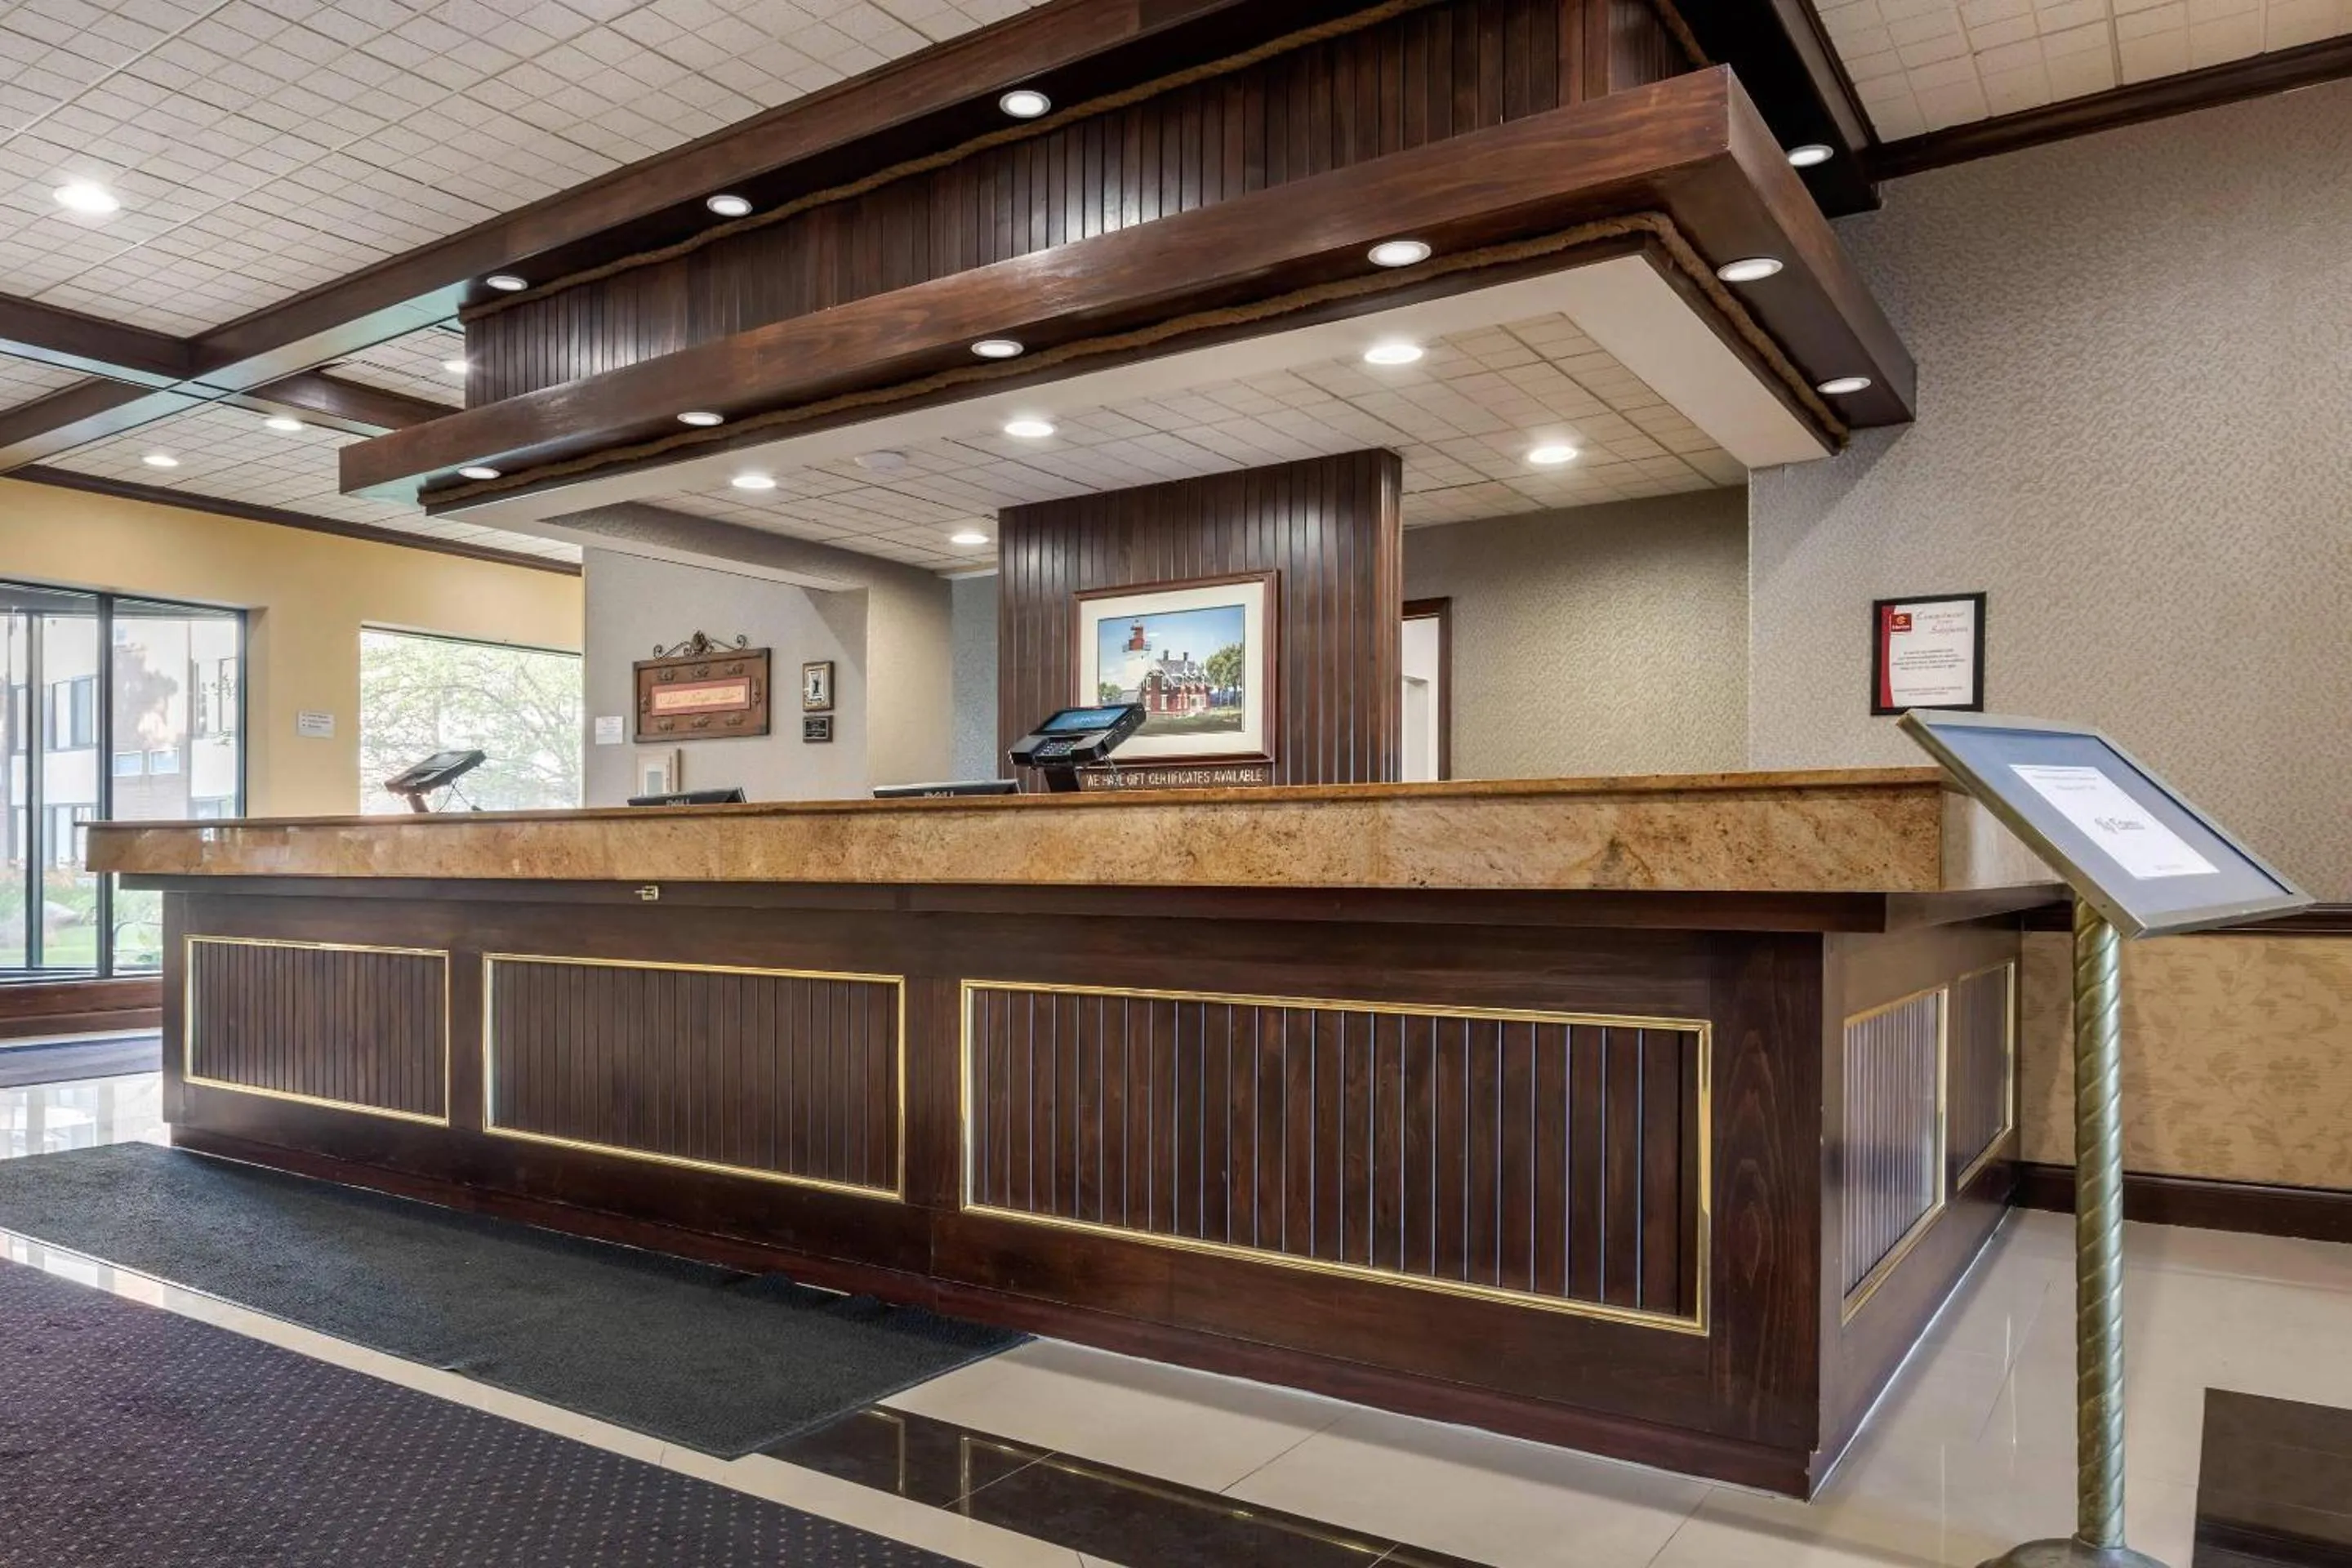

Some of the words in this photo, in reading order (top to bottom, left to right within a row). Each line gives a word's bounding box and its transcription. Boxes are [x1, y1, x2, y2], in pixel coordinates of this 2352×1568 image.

[1086, 774, 1100, 787] WE
[1127, 773, 1145, 785] GIFT
[1148, 771, 1209, 785] CERTIFICATES
[1213, 768, 1263, 783] AVAILABLE
